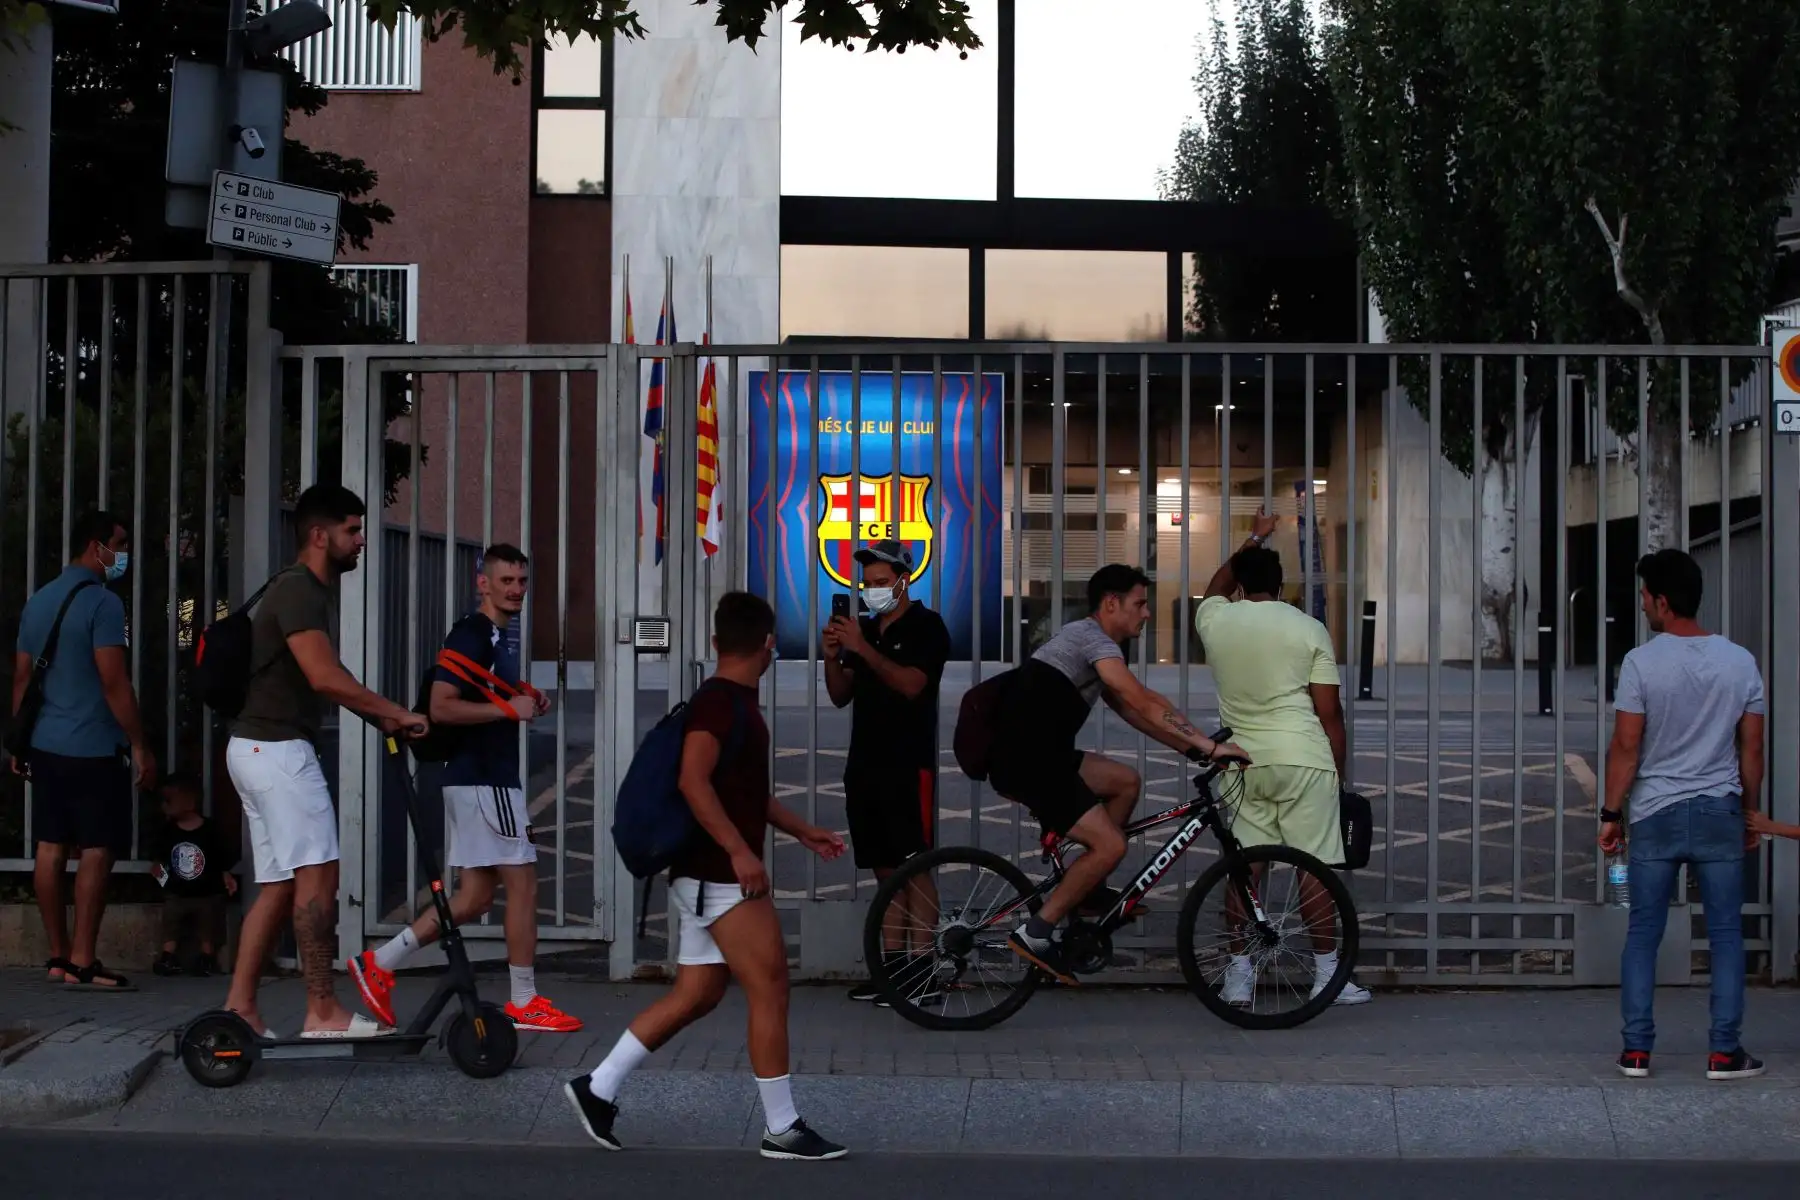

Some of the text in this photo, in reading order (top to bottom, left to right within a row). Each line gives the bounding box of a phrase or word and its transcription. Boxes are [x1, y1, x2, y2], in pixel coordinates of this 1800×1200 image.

[253, 185, 275, 200] Club
[250, 208, 292, 227] Personal
[295, 216, 316, 232] Club
[248, 229, 278, 247] Públic
[903, 421, 934, 434] CLU
